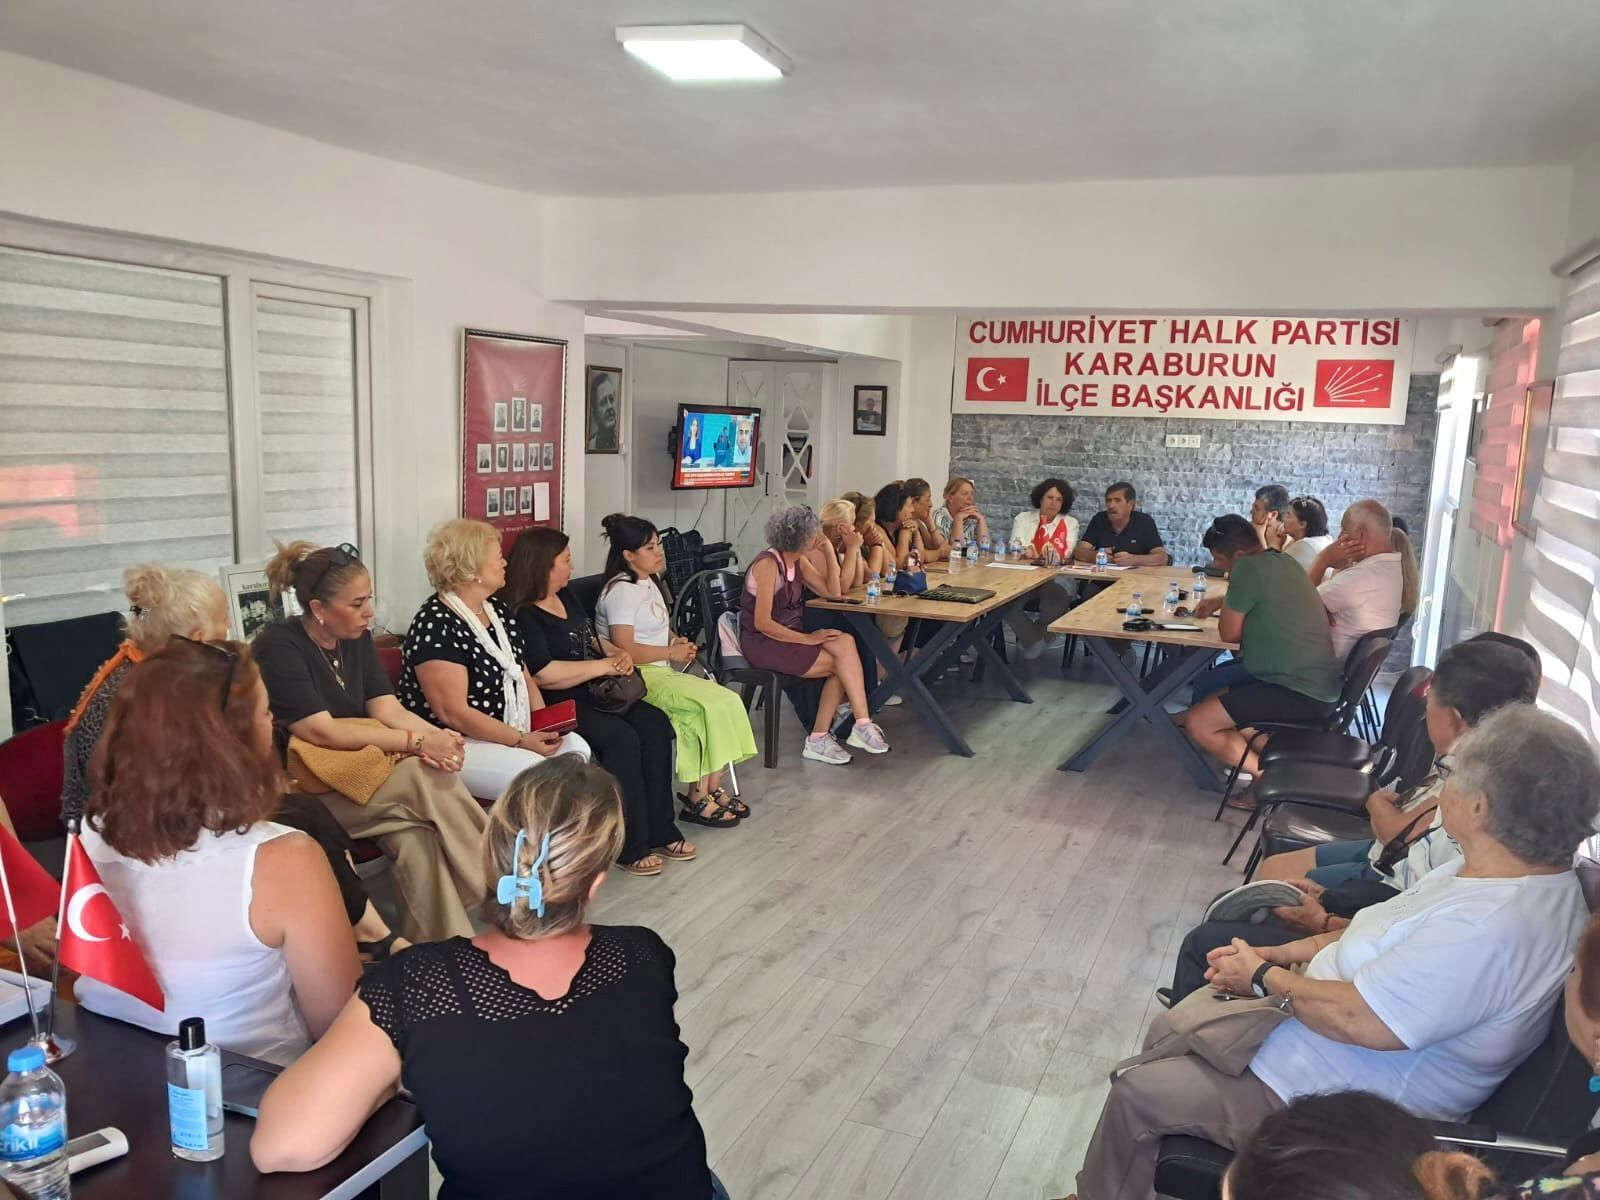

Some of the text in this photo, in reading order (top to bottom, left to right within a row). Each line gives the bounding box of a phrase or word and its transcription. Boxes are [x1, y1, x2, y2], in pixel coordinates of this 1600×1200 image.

[969, 315, 1157, 344] CUMHURİYET
[1169, 319, 1259, 344] HALK
[1064, 352, 1276, 378] KARABURUN
[1036, 378, 1305, 413] İLÇE BAŞKANLIĞI
